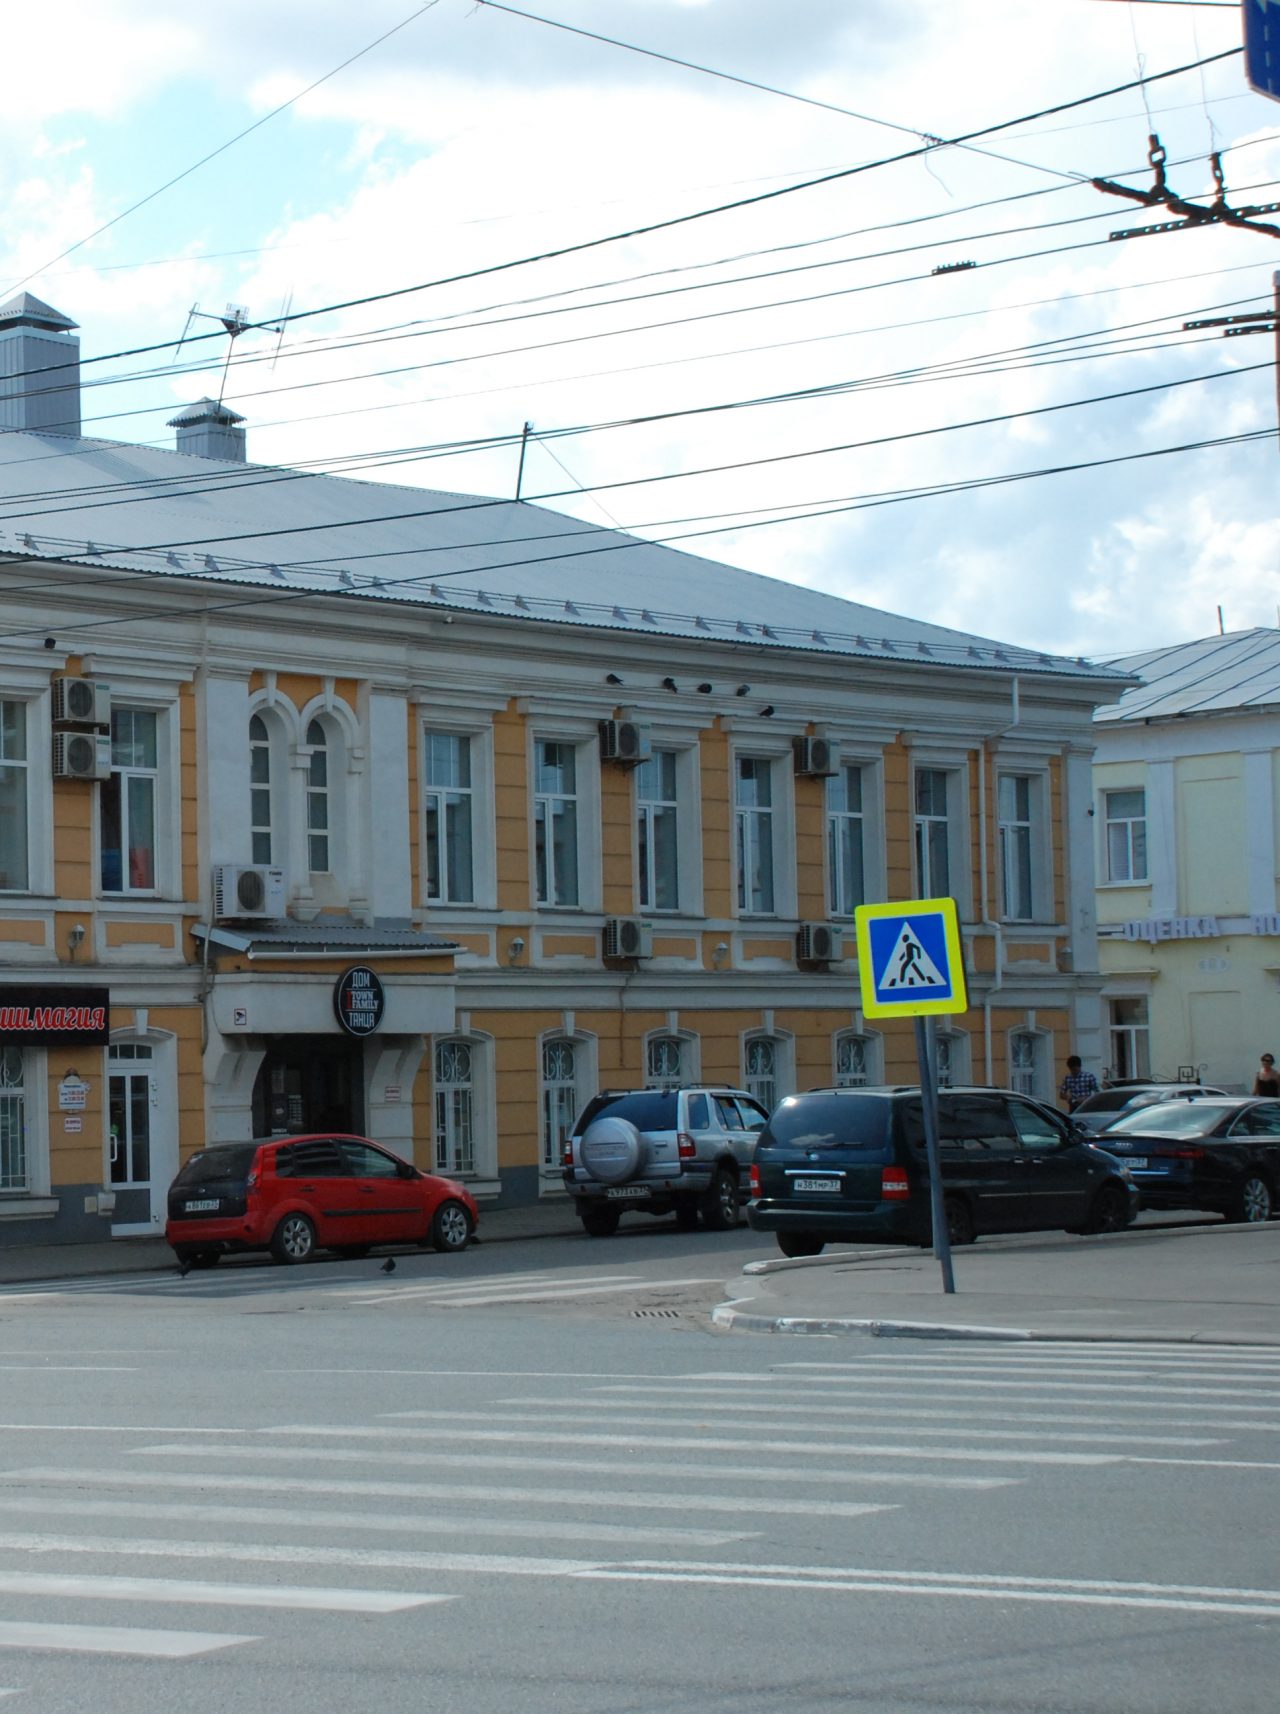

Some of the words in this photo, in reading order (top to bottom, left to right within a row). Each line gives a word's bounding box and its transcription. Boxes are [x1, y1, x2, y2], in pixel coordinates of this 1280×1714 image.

[1123, 916, 1220, 944] ОЦЕНКА
[352, 971, 370, 988] ДОМ
[352, 991, 374, 1000] TOWN
[352, 1000, 379, 1009] FAMILY
[349, 1012, 375, 1028] ТАНЦА
